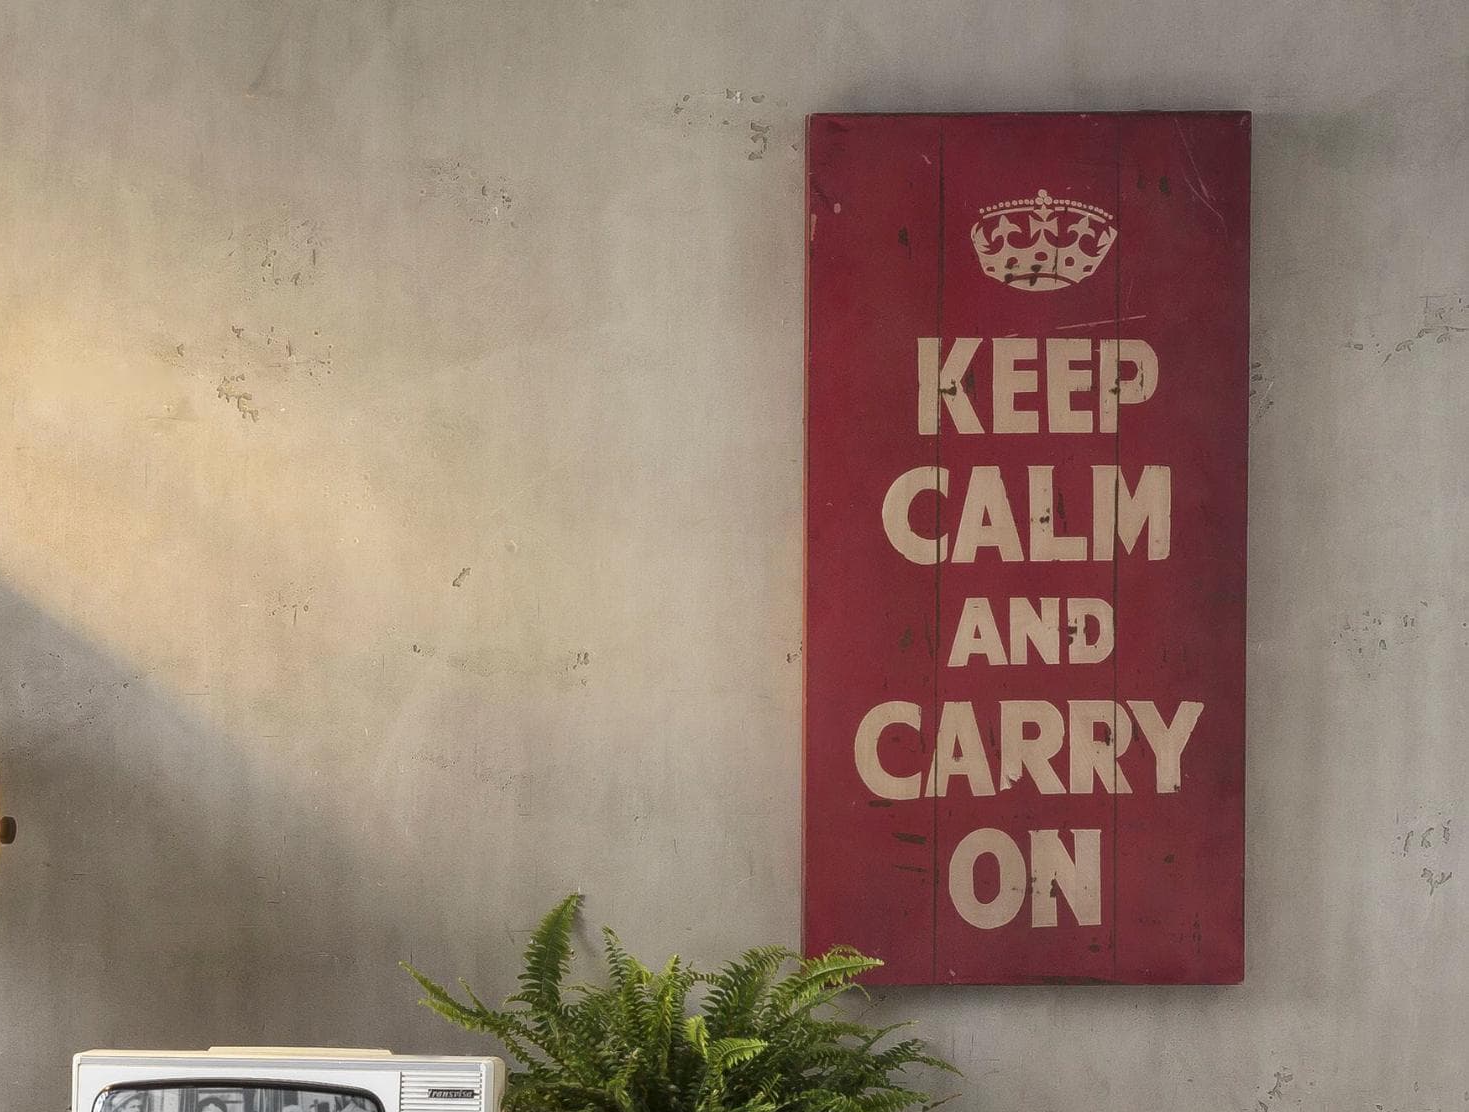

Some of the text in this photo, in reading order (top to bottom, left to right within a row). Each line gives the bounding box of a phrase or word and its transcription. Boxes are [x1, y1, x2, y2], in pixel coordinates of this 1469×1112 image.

[917, 337, 1159, 436] KEEP
[881, 464, 1172, 565] CALM
[948, 597, 1115, 668] AND
[854, 699, 1204, 801] CARRY
[948, 827, 1102, 930] ON
